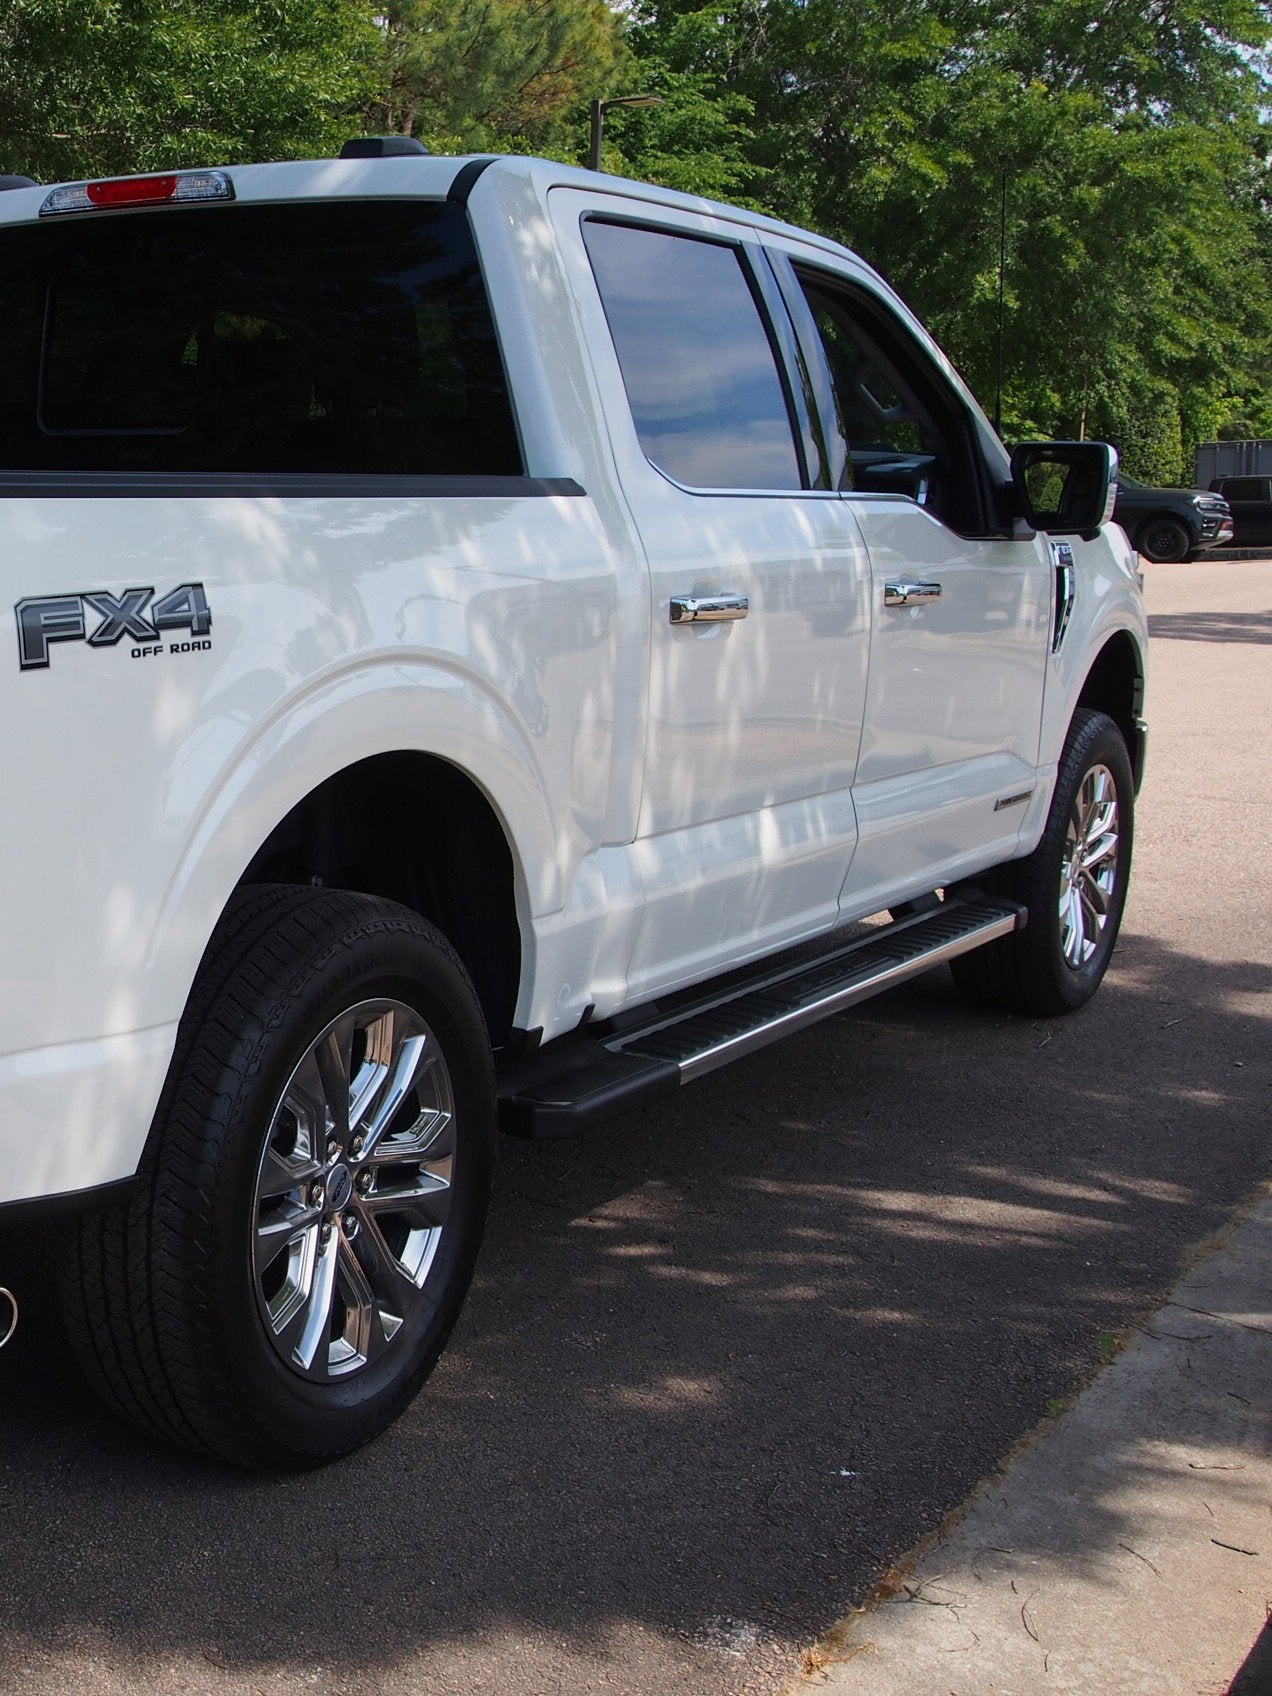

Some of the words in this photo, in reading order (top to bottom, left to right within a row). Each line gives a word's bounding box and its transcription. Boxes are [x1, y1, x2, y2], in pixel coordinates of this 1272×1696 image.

[14, 582, 213, 673] FX4
[131, 645, 164, 659] OFF
[170, 640, 212, 654] ROAD
